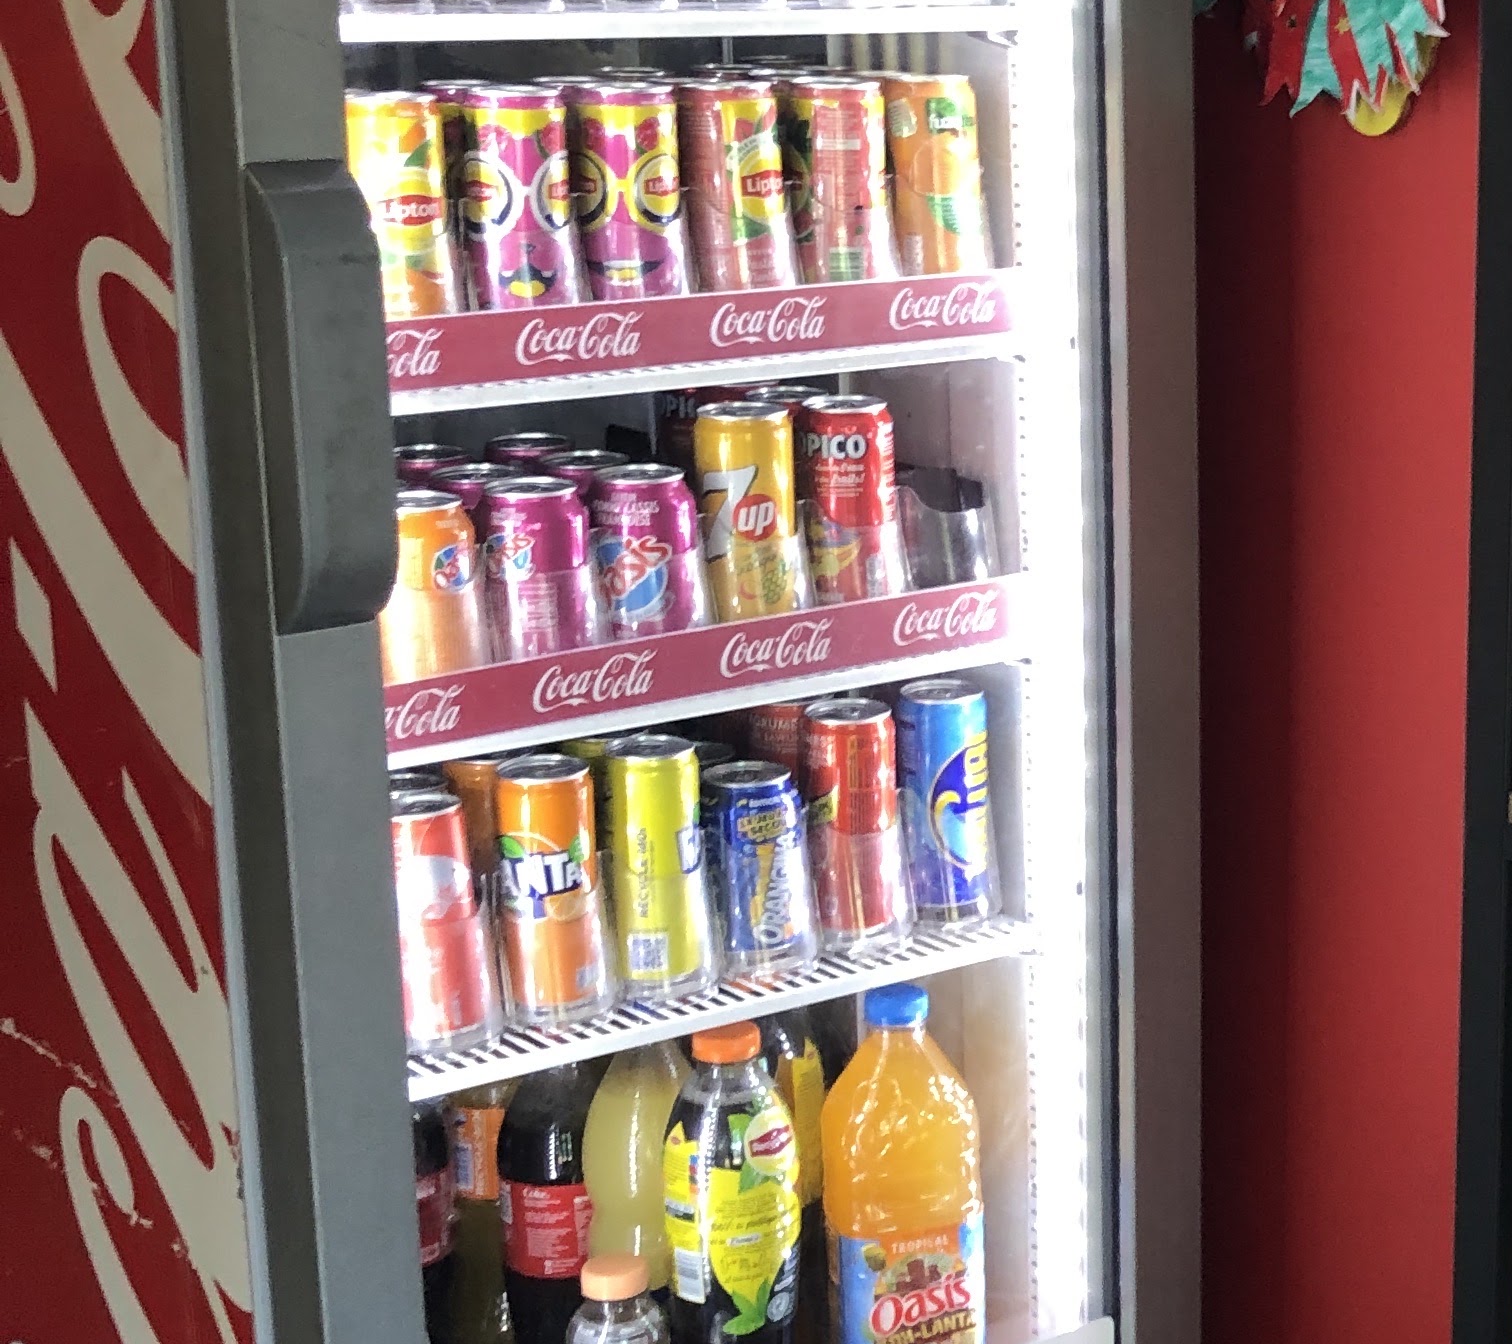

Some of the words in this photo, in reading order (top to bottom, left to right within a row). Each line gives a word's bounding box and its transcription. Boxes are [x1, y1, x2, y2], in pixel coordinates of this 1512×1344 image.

[710, 296, 827, 348] Coca-Cola
[889, 280, 998, 331] Coca-Cola
[515, 311, 644, 366] Coca-Cola
[892, 590, 1000, 647] Coca-Cola
[720, 617, 835, 678] Coca-Cola
[533, 649, 658, 713] Coca-Cola
[869, 1272, 971, 1336] Oasis
